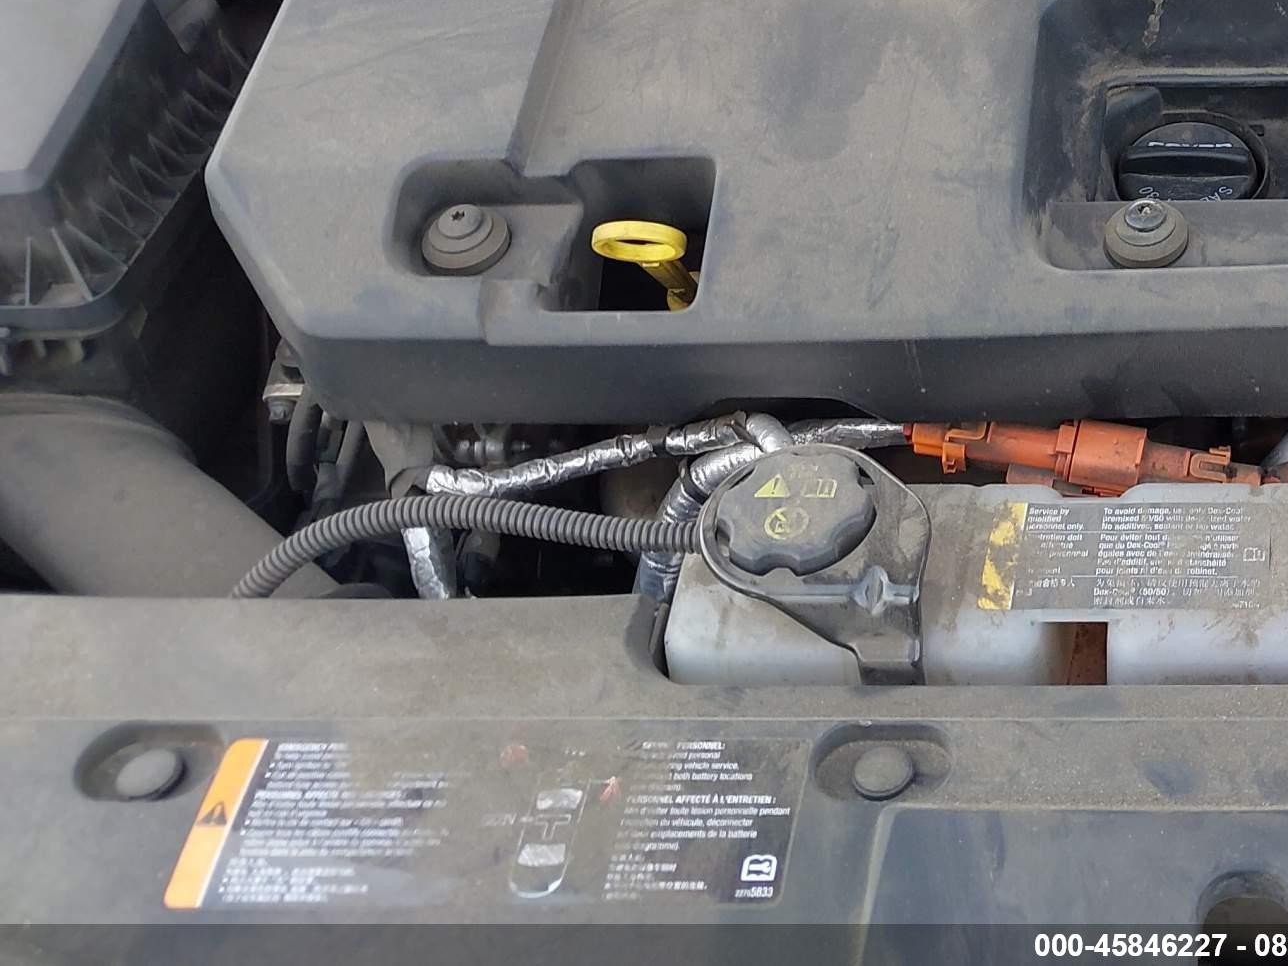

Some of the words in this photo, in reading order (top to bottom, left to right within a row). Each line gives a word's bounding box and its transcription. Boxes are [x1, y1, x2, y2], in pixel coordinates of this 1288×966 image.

[1029, 507, 1058, 515] Service
[1060, 506, 1070, 516] by
[1104, 507, 1113, 515] To
[1114, 507, 1136, 515] avoid
[1103, 515, 1139, 524] premixed
[1067, 523, 1084, 532] only.
[689, 751, 721, 760] personal
[684, 762, 709, 770] vehicle
[711, 762, 739, 771] service,
[673, 772, 690, 781] both
[692, 772, 718, 782] battery
[719, 772, 753, 781] locations
[675, 793, 711, 804] AFFECTÉ
[759, 807, 791, 817] pendant
[672, 818, 705, 828] véhicule,
[706, 818, 753, 827] déconnecter
[728, 830, 758, 839] batterie
